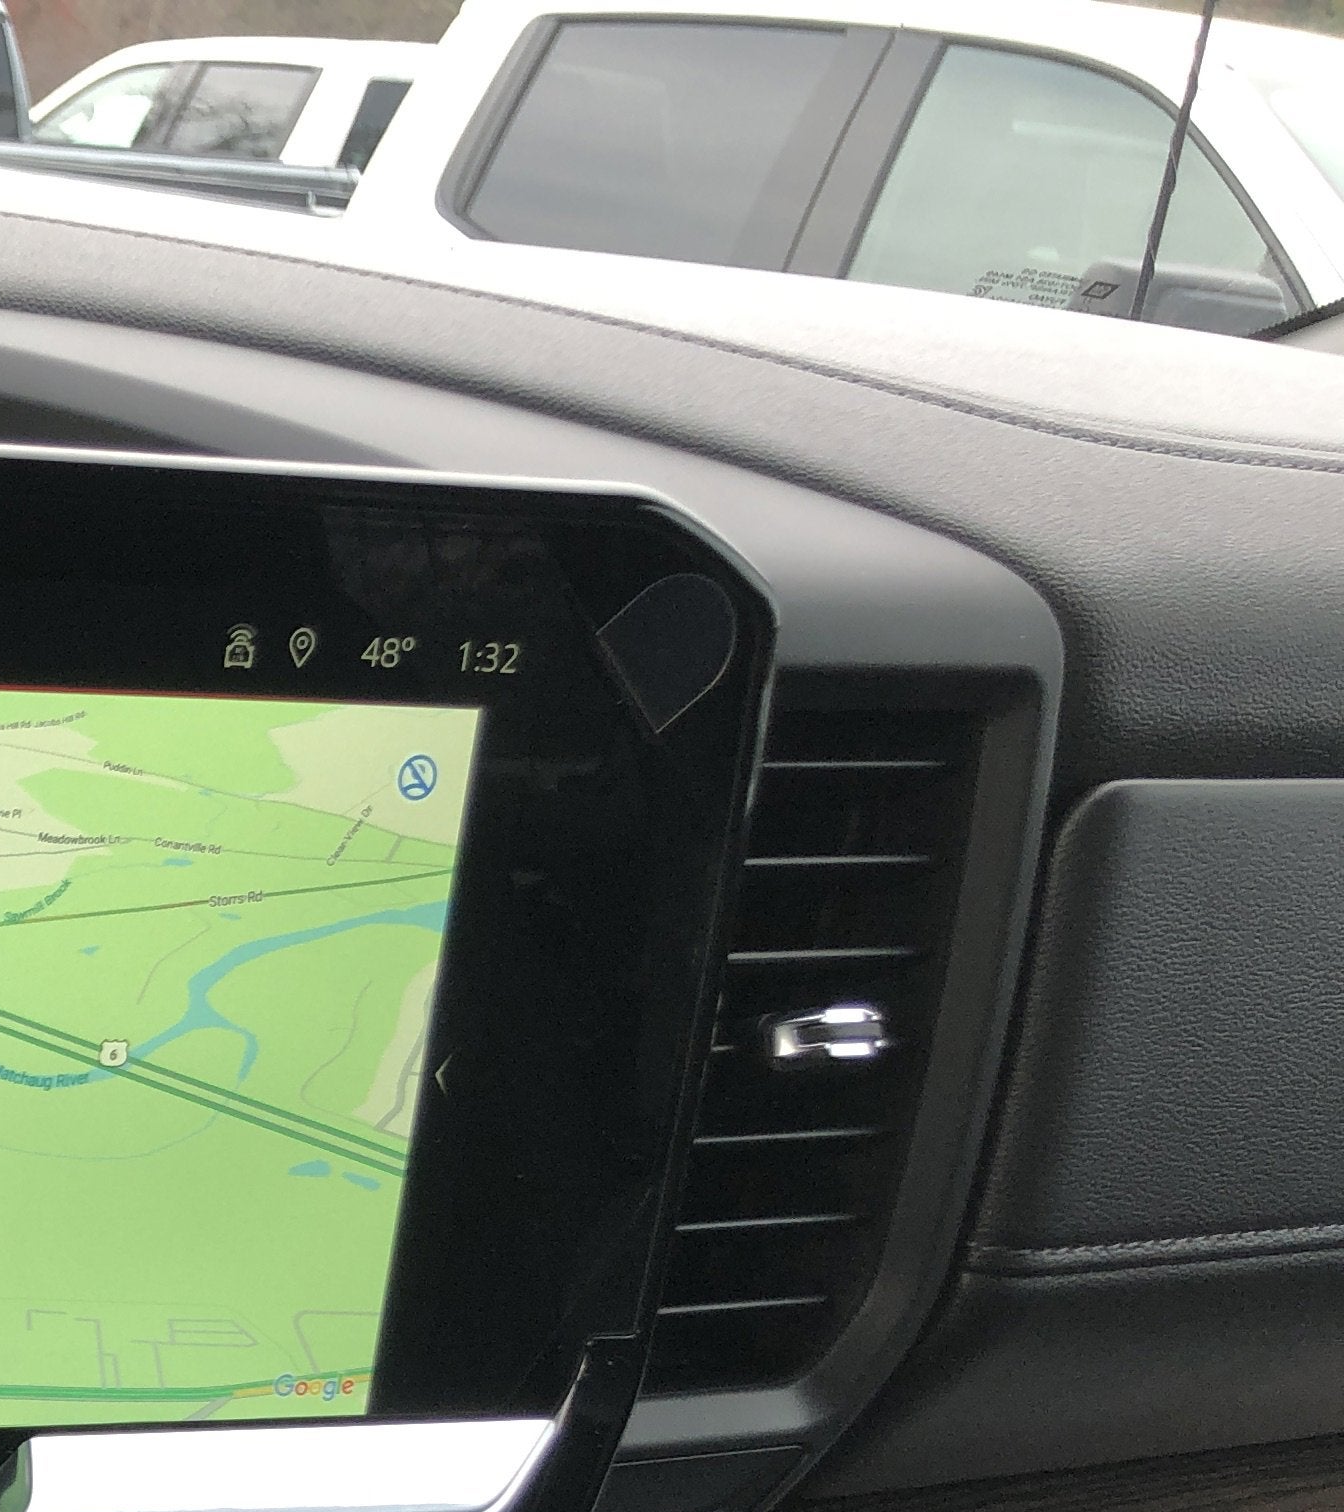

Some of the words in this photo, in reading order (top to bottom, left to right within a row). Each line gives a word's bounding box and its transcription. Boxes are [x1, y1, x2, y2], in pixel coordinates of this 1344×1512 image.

[458, 640, 520, 674] 1:32
[37, 831, 106, 845] Meadowbrook
[107, 834, 121, 845] Ln
[206, 843, 222, 856] Rd
[208, 893, 246, 908] Storrs
[247, 889, 264, 904] Rd
[109, 1048, 118, 1061] 6
[55, 1070, 90, 1089] River
[273, 1373, 355, 1402] Google
